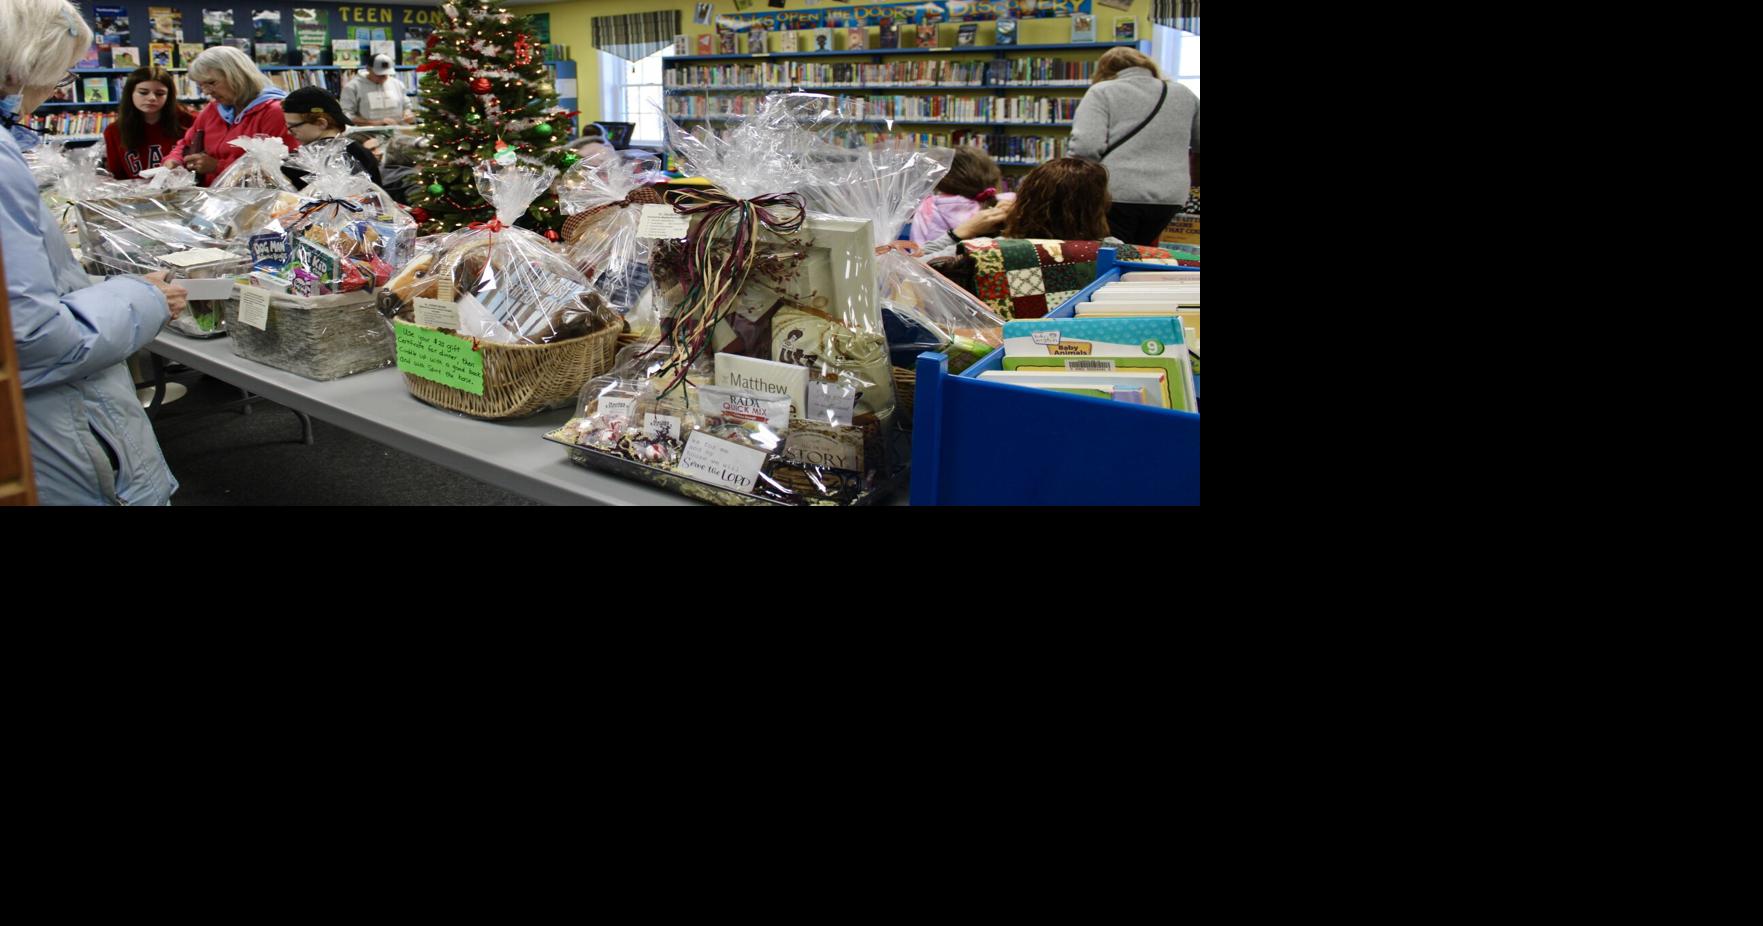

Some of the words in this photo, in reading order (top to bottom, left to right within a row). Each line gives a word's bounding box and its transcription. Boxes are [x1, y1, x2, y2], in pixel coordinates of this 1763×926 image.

[339, 6, 393, 23] TEEN
[403, 9, 442, 24] ZON
[776, 12, 820, 22] OPEN
[854, 5, 916, 19] DOORS
[253, 241, 270, 255] DOG
[270, 240, 286, 253] MAN
[403, 328, 414, 337] Use
[447, 345, 460, 353] gift
[1147, 340, 1159, 354] 9
[730, 371, 788, 395] Matthew
[723, 402, 749, 413] QUICK
[751, 406, 768, 417] MIX
[729, 394, 760, 408] RADA
[785, 448, 846, 467] STORY
[720, 468, 752, 487] LORD
